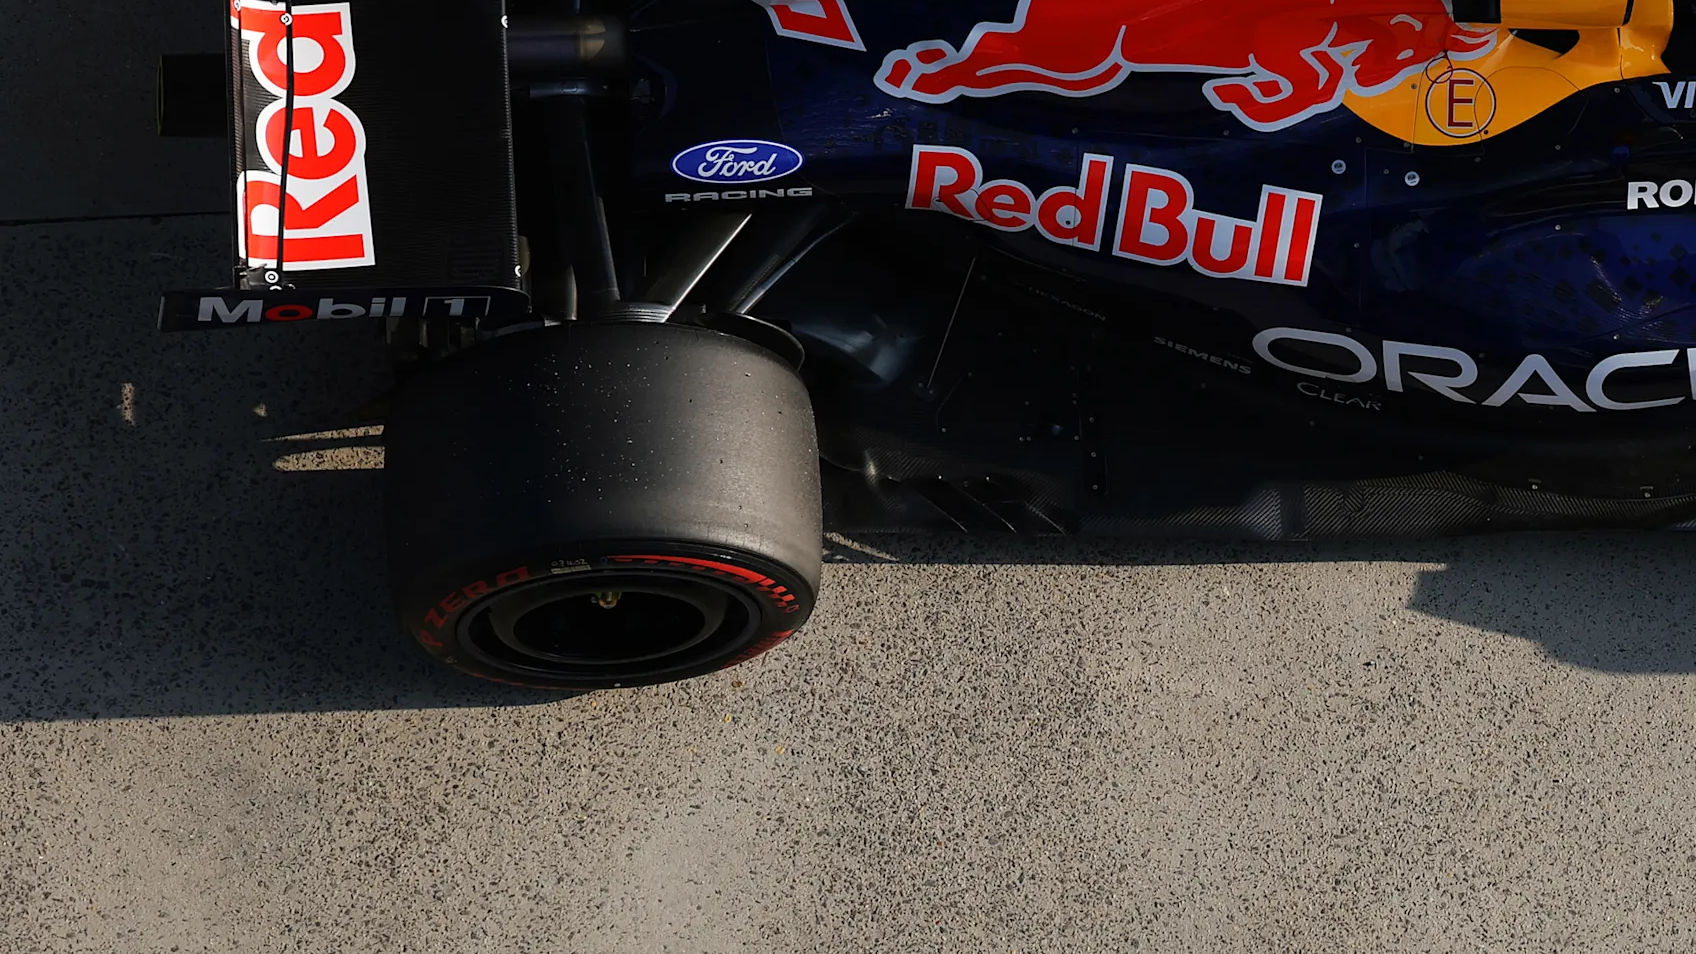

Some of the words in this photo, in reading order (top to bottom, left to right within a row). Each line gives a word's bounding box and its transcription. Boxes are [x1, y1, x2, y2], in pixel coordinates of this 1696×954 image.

[1448, 77, 1475, 128] E
[697, 141, 777, 179] Ford
[664, 186, 813, 203] RACING
[909, 148, 1108, 248] Red
[1116, 166, 1320, 284] Bull
[197, 297, 406, 323] Mobil
[1152, 335, 1252, 375] SIEMENS
[1296, 381, 1384, 411] CLEAR
[424, 565, 533, 629] ZERO
